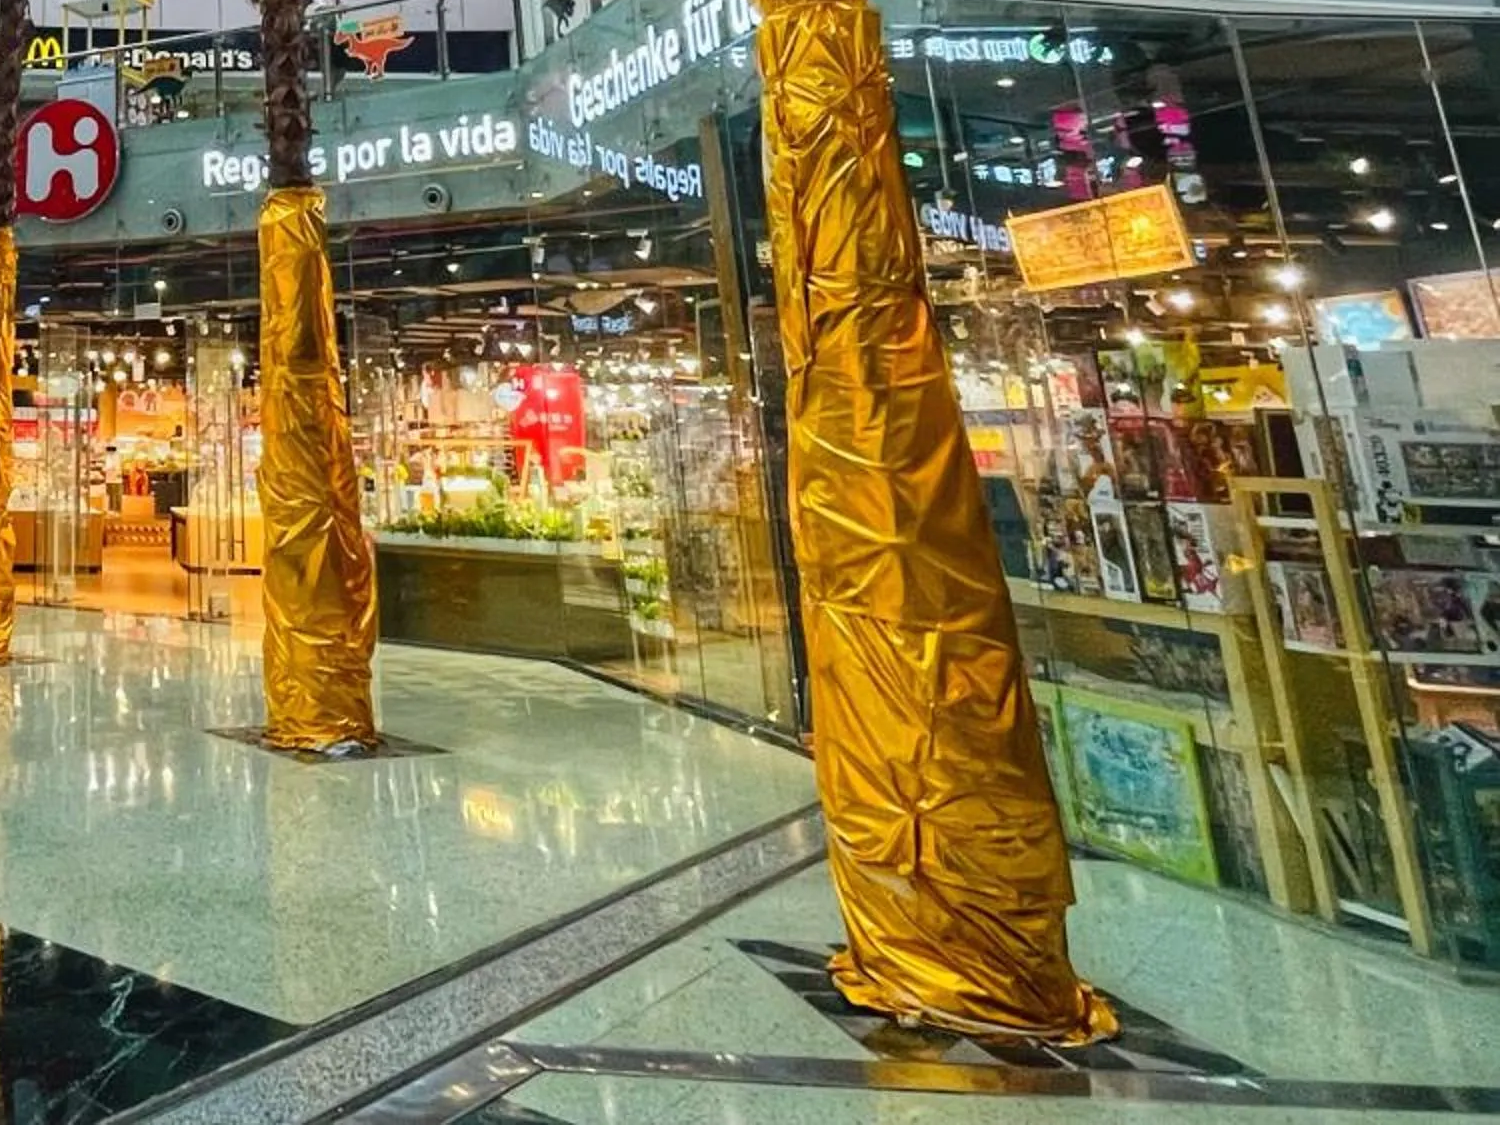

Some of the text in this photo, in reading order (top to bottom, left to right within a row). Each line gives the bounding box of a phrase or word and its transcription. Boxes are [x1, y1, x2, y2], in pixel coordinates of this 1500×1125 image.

[567, 23, 681, 128] Geschenke
[337, 138, 393, 183] por
[400, 125, 432, 164] la
[439, 114, 518, 157] vida
